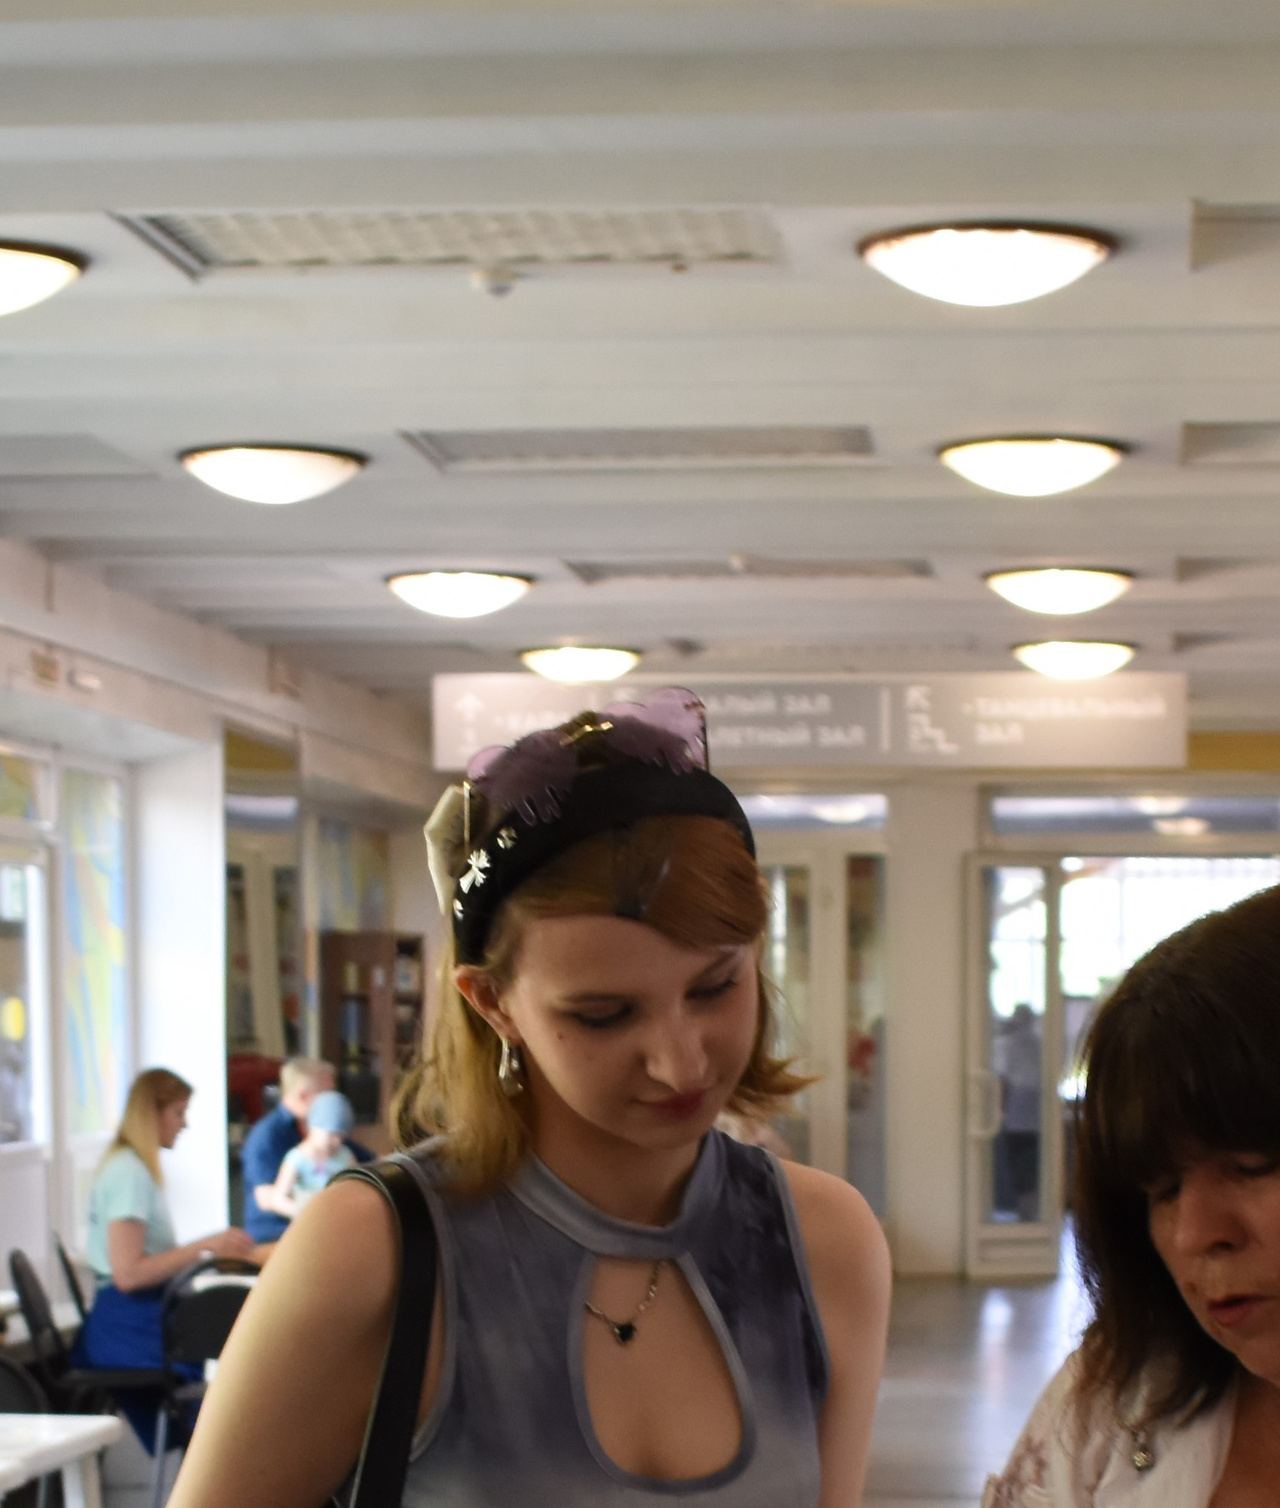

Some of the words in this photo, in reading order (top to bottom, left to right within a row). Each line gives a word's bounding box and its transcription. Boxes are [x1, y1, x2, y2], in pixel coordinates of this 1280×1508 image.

[705, 690, 777, 713] АЛЫЙ
[783, 693, 832, 713] ЗАЛ
[818, 725, 867, 745] ЗАЛ
[975, 722, 1024, 745] ЗАЛ
